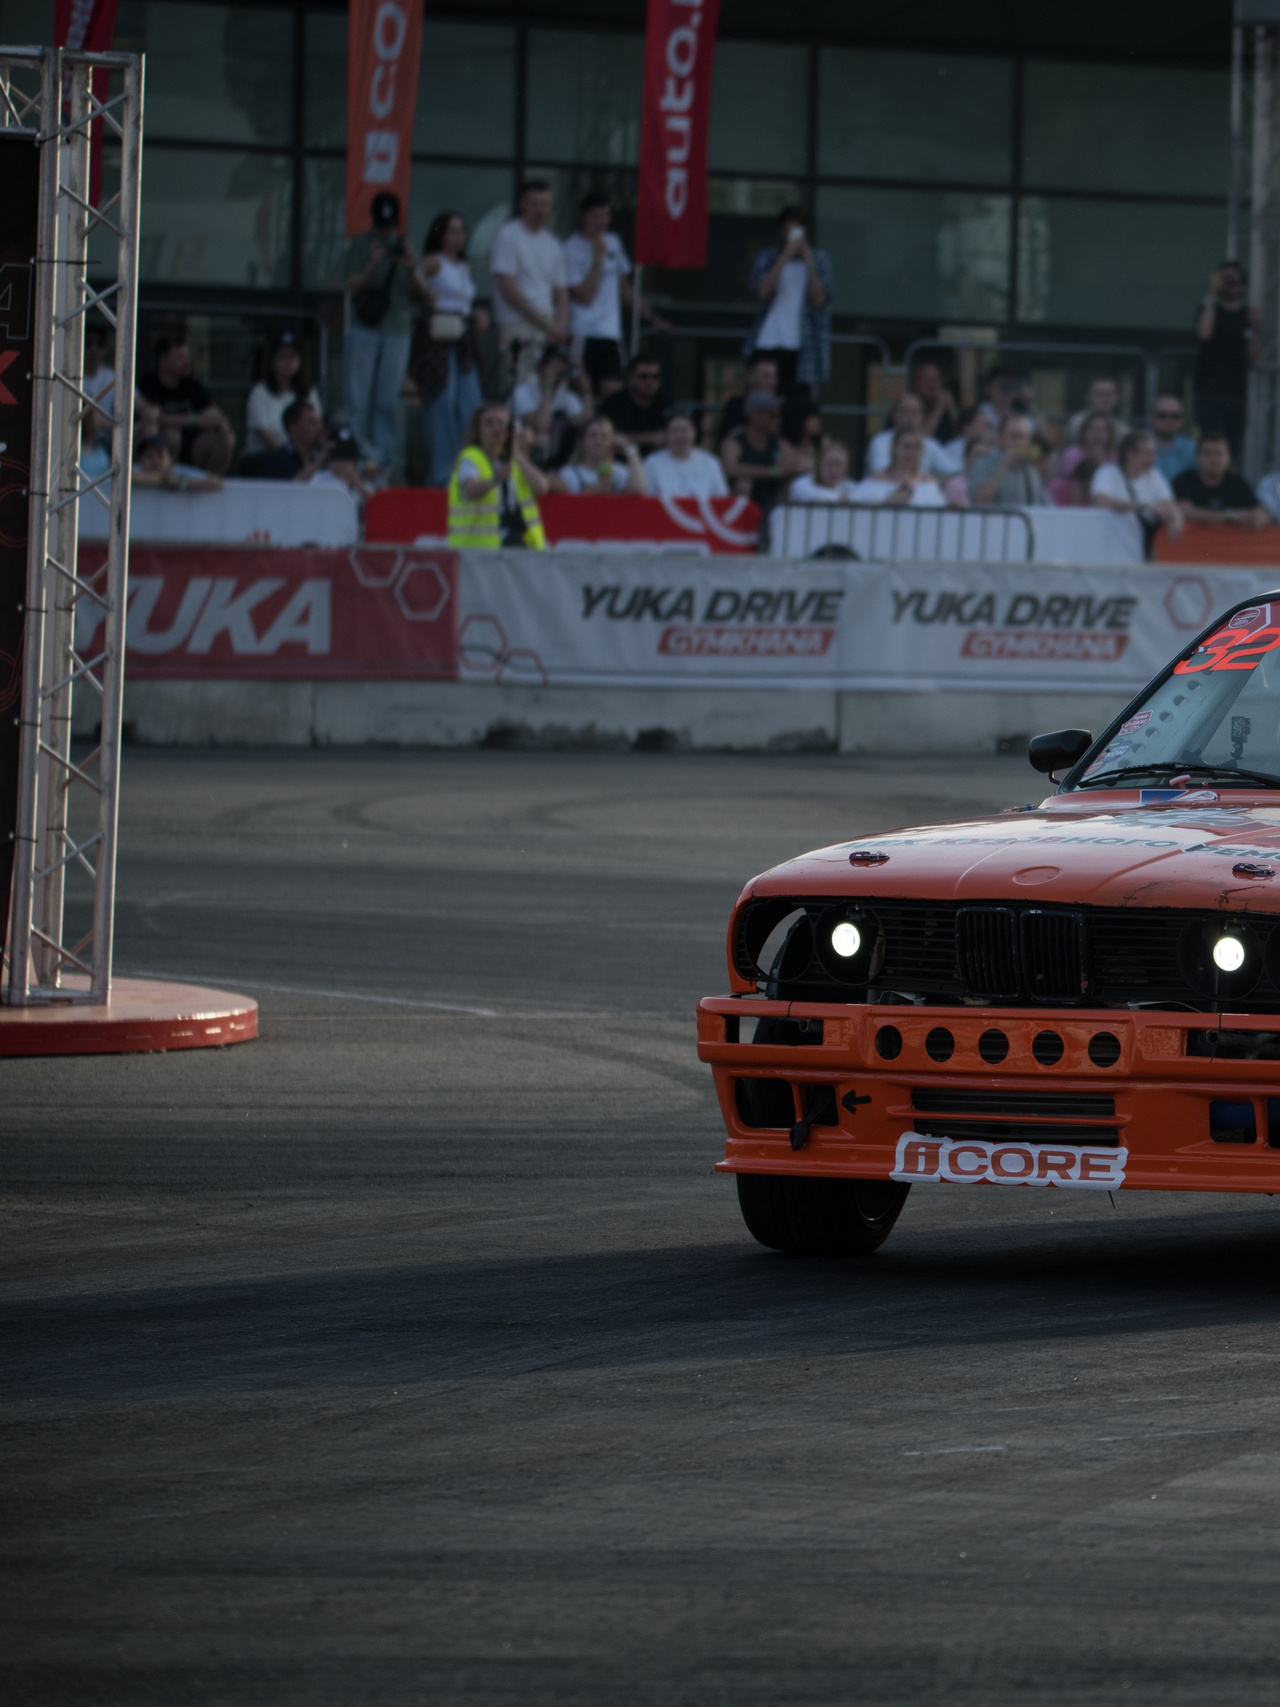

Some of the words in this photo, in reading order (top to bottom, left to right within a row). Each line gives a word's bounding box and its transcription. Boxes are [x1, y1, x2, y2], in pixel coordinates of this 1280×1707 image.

[660, 0, 702, 219] auto.
[581, 586, 695, 623] YUKA
[704, 588, 845, 624] DRIVE
[891, 590, 997, 627] YUKA
[1005, 594, 1139, 630] DRIVE
